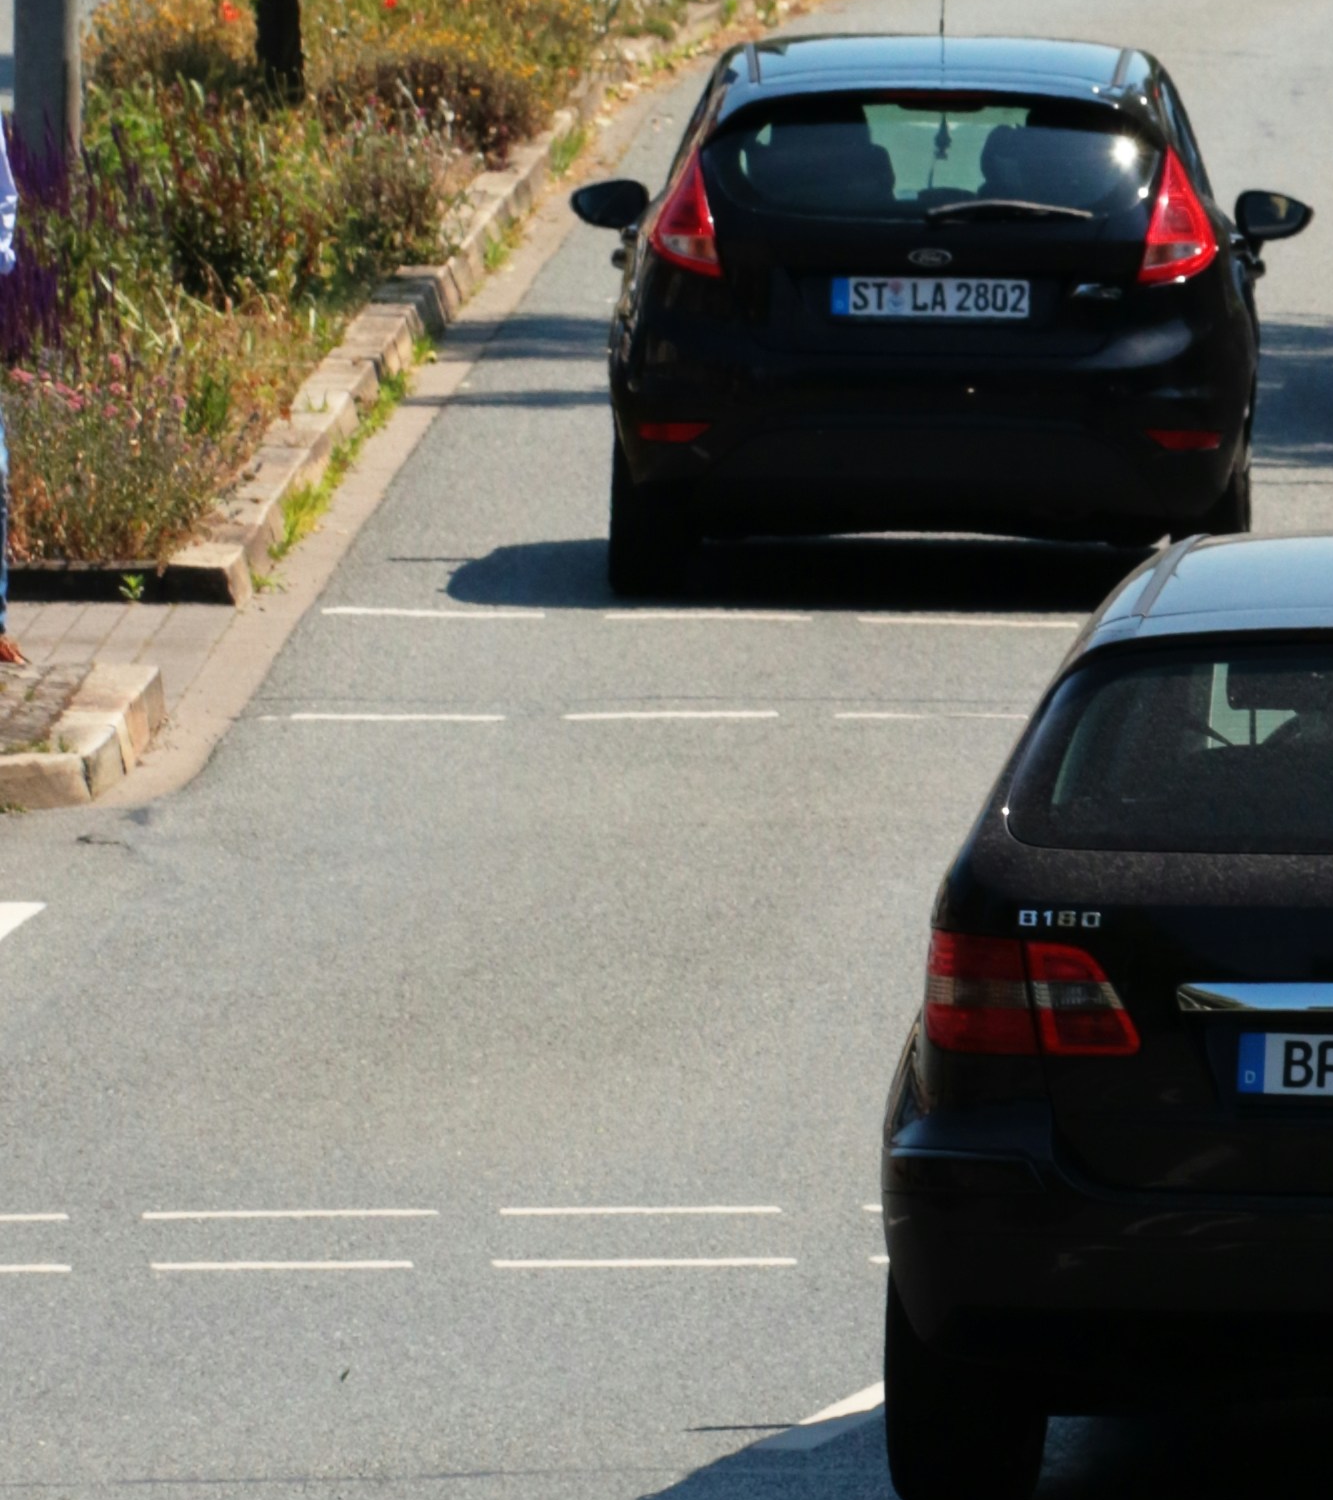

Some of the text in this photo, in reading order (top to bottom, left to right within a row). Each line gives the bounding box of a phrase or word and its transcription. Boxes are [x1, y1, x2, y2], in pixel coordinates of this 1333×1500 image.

[853, 281, 1026, 313] ST LA 2802
[1019, 909, 1101, 928] B180
